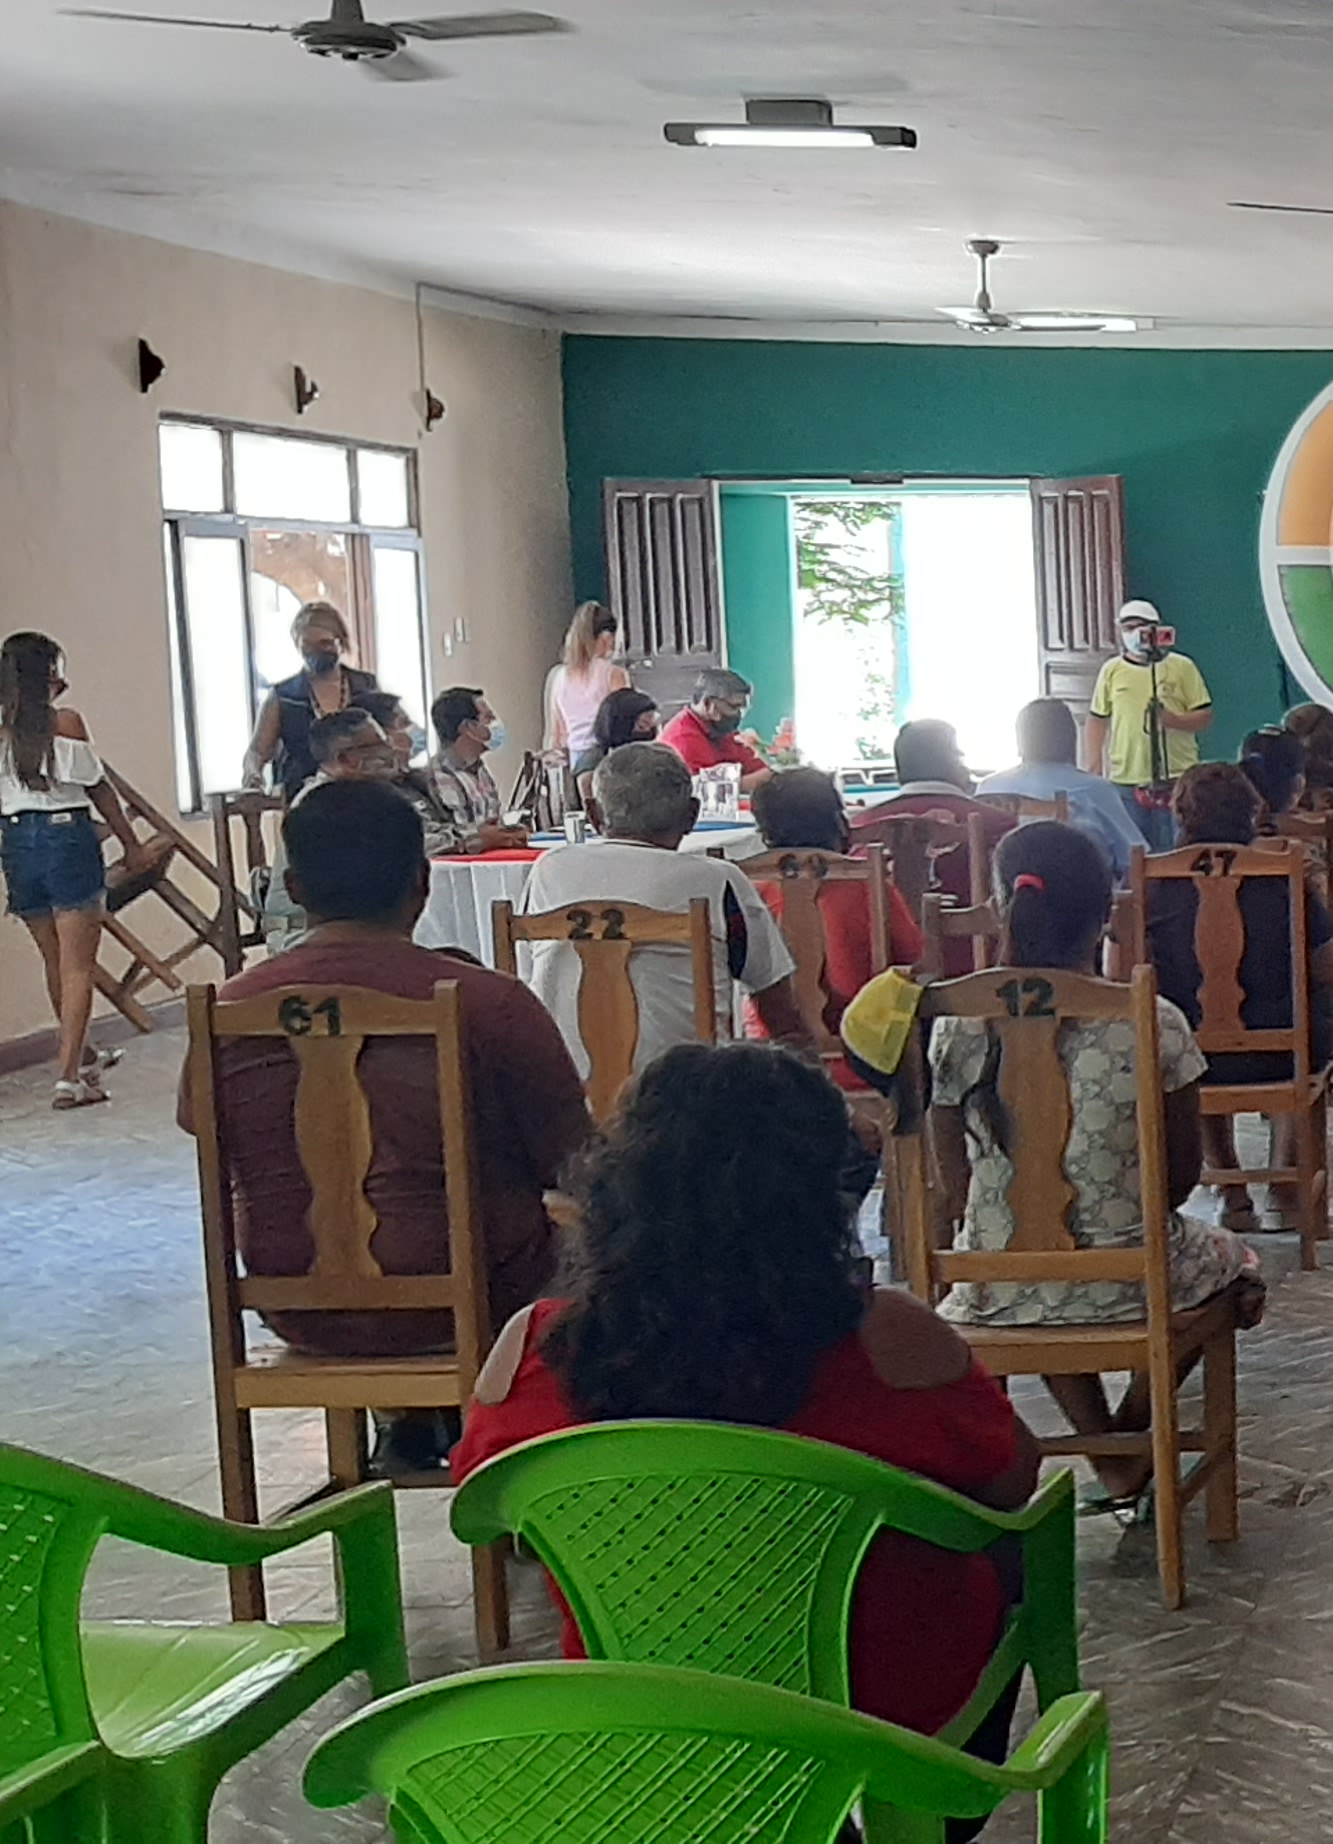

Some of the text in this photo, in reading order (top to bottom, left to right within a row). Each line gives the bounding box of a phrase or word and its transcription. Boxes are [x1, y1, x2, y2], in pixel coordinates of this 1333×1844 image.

[1190, 848, 1238, 877] 47
[567, 909, 625, 940] 22
[995, 977, 1056, 1017] 12
[278, 995, 341, 1036] 61
